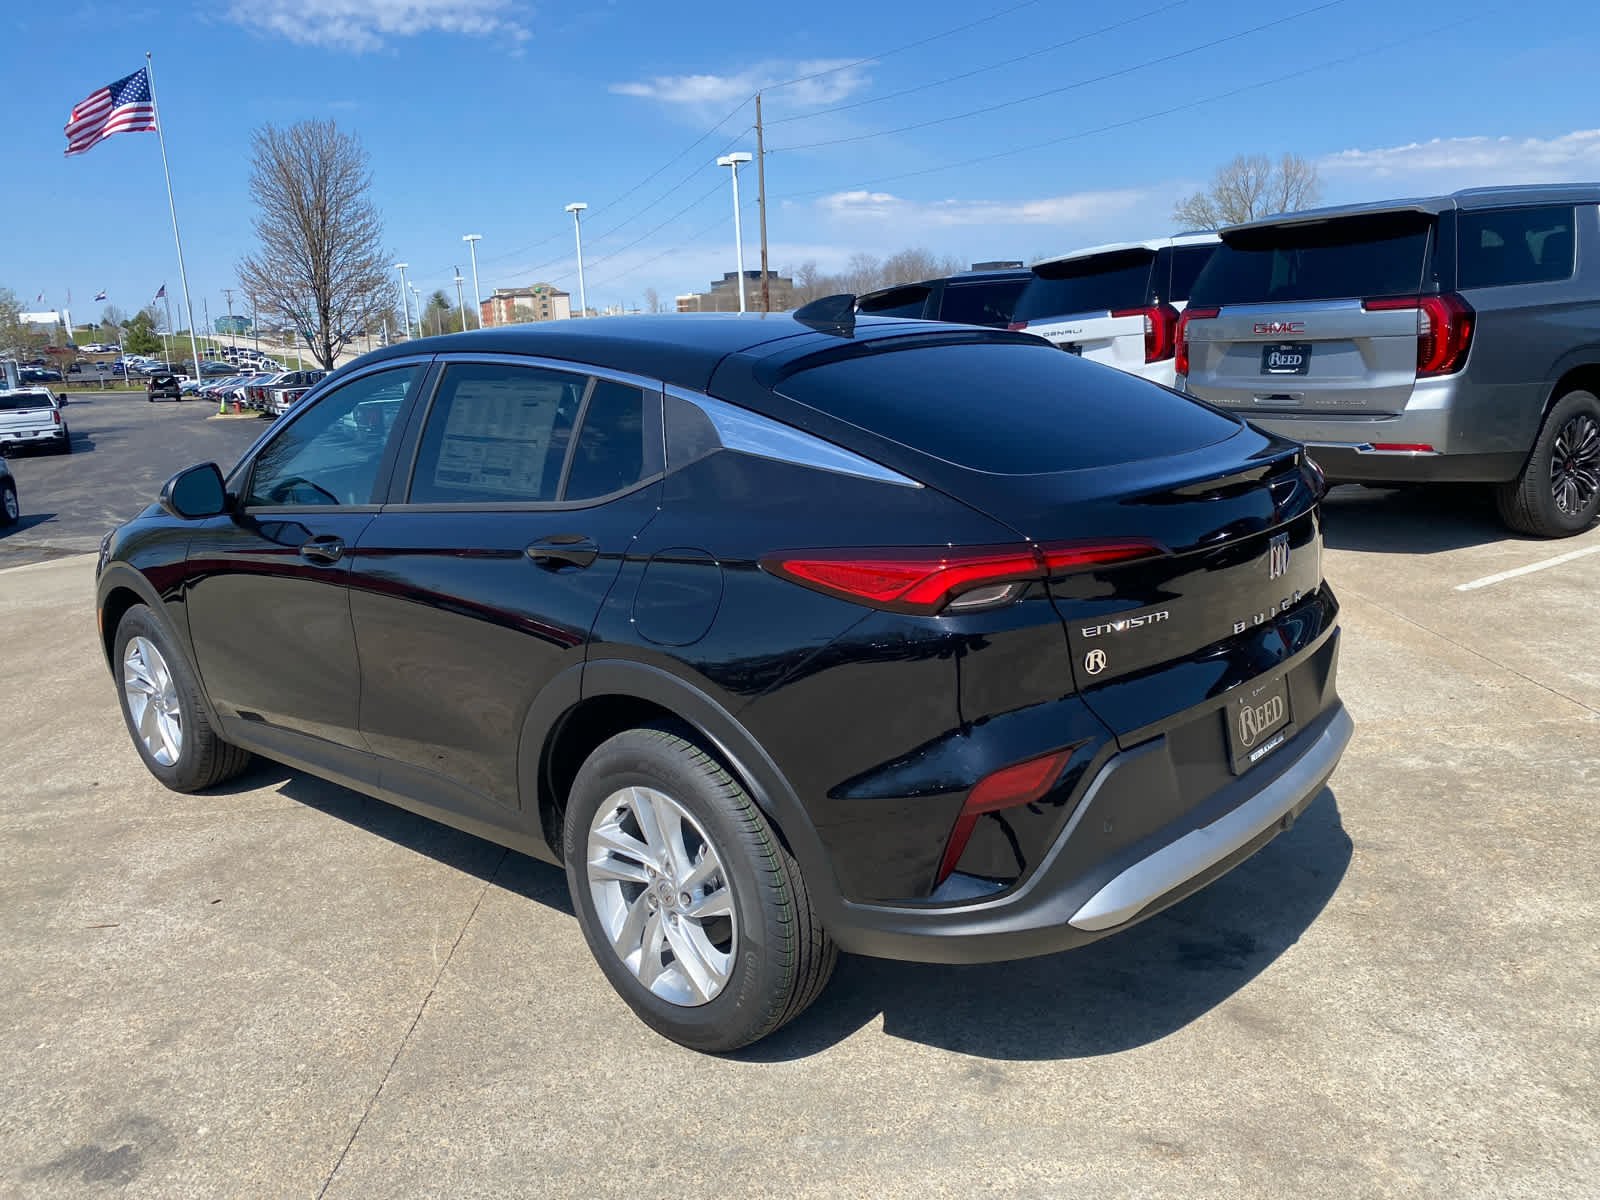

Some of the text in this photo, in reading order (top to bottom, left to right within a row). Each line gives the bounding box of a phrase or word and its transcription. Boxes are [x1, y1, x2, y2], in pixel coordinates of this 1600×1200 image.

[1254, 321, 1305, 335] GMC
[1081, 610, 1169, 638] ENVISTA
[1233, 590, 1302, 635] BUICK
[1239, 695, 1283, 747] REED
